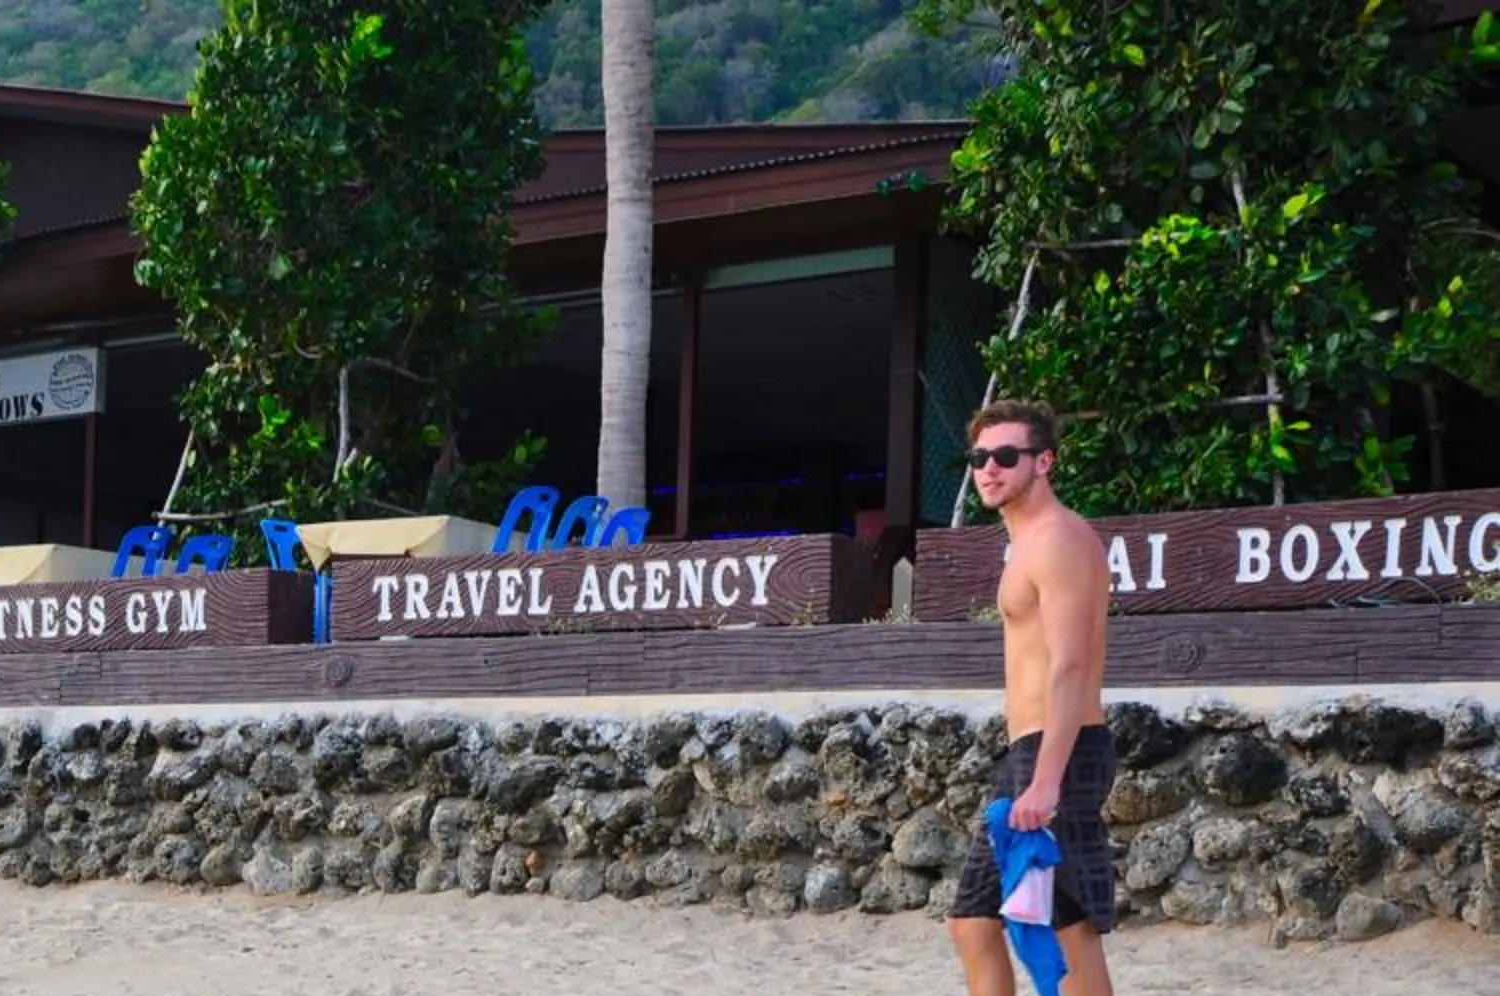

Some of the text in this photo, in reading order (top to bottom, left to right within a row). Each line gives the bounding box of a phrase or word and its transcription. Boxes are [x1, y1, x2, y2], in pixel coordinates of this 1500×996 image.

[1235, 511, 1500, 583] BOXING
[125, 587, 207, 634] GYM
[372, 554, 778, 622] TRAVEL AGENCY
